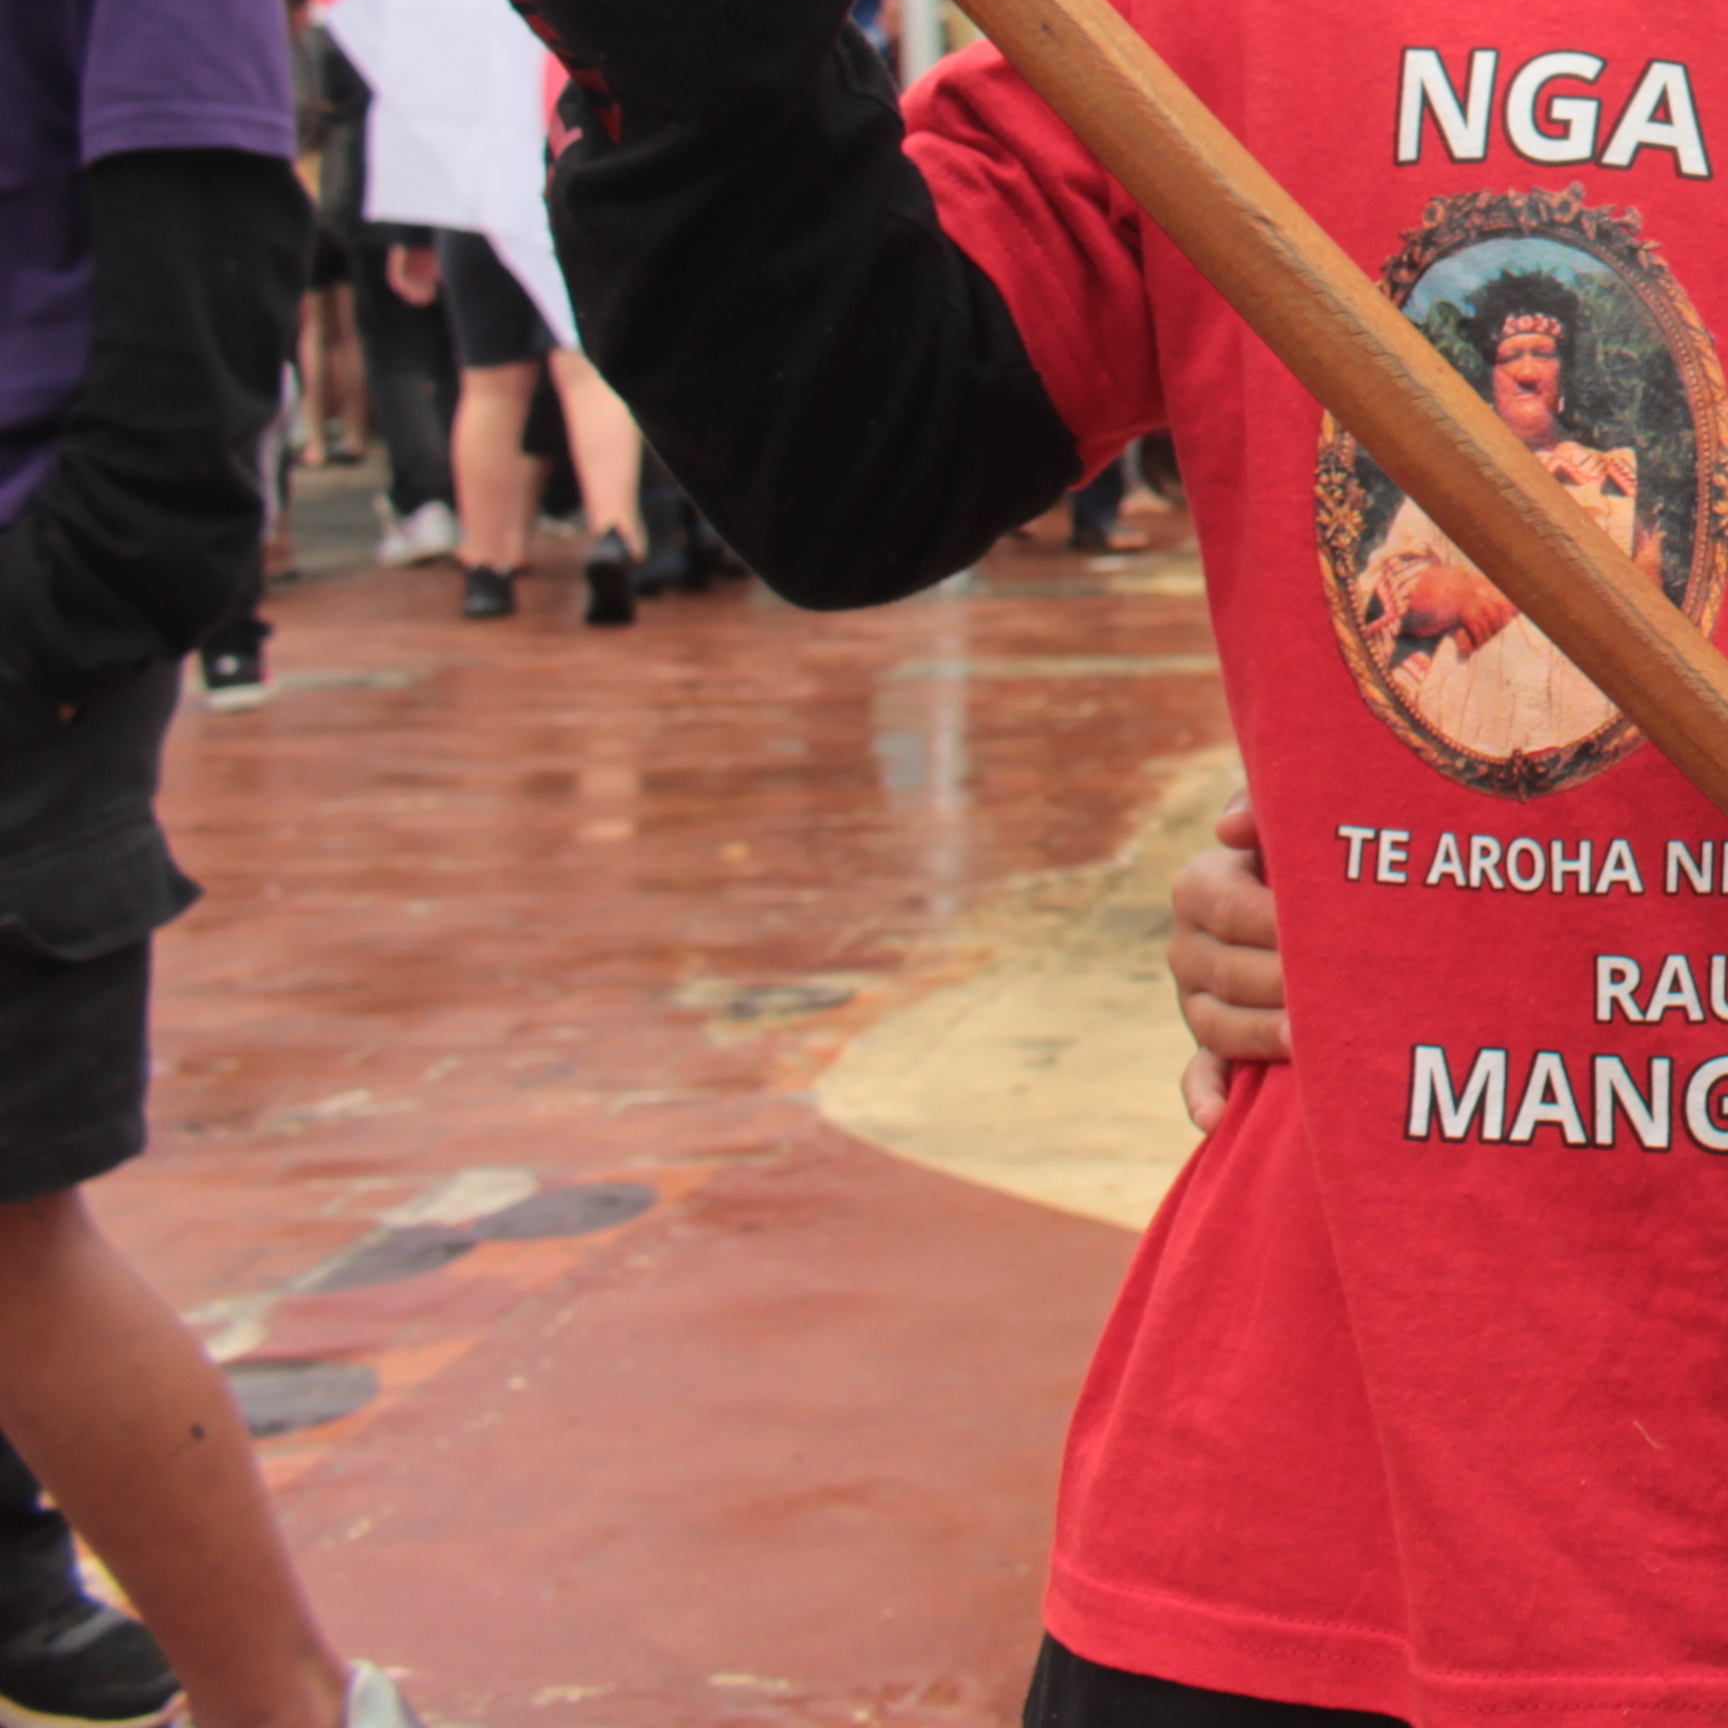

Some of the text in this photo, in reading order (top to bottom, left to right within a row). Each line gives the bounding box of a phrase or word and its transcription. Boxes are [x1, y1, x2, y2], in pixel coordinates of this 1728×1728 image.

[1394, 45, 1713, 181] NGA
[1336, 823, 1410, 886] TE
[1424, 830, 1644, 898] AROHA
